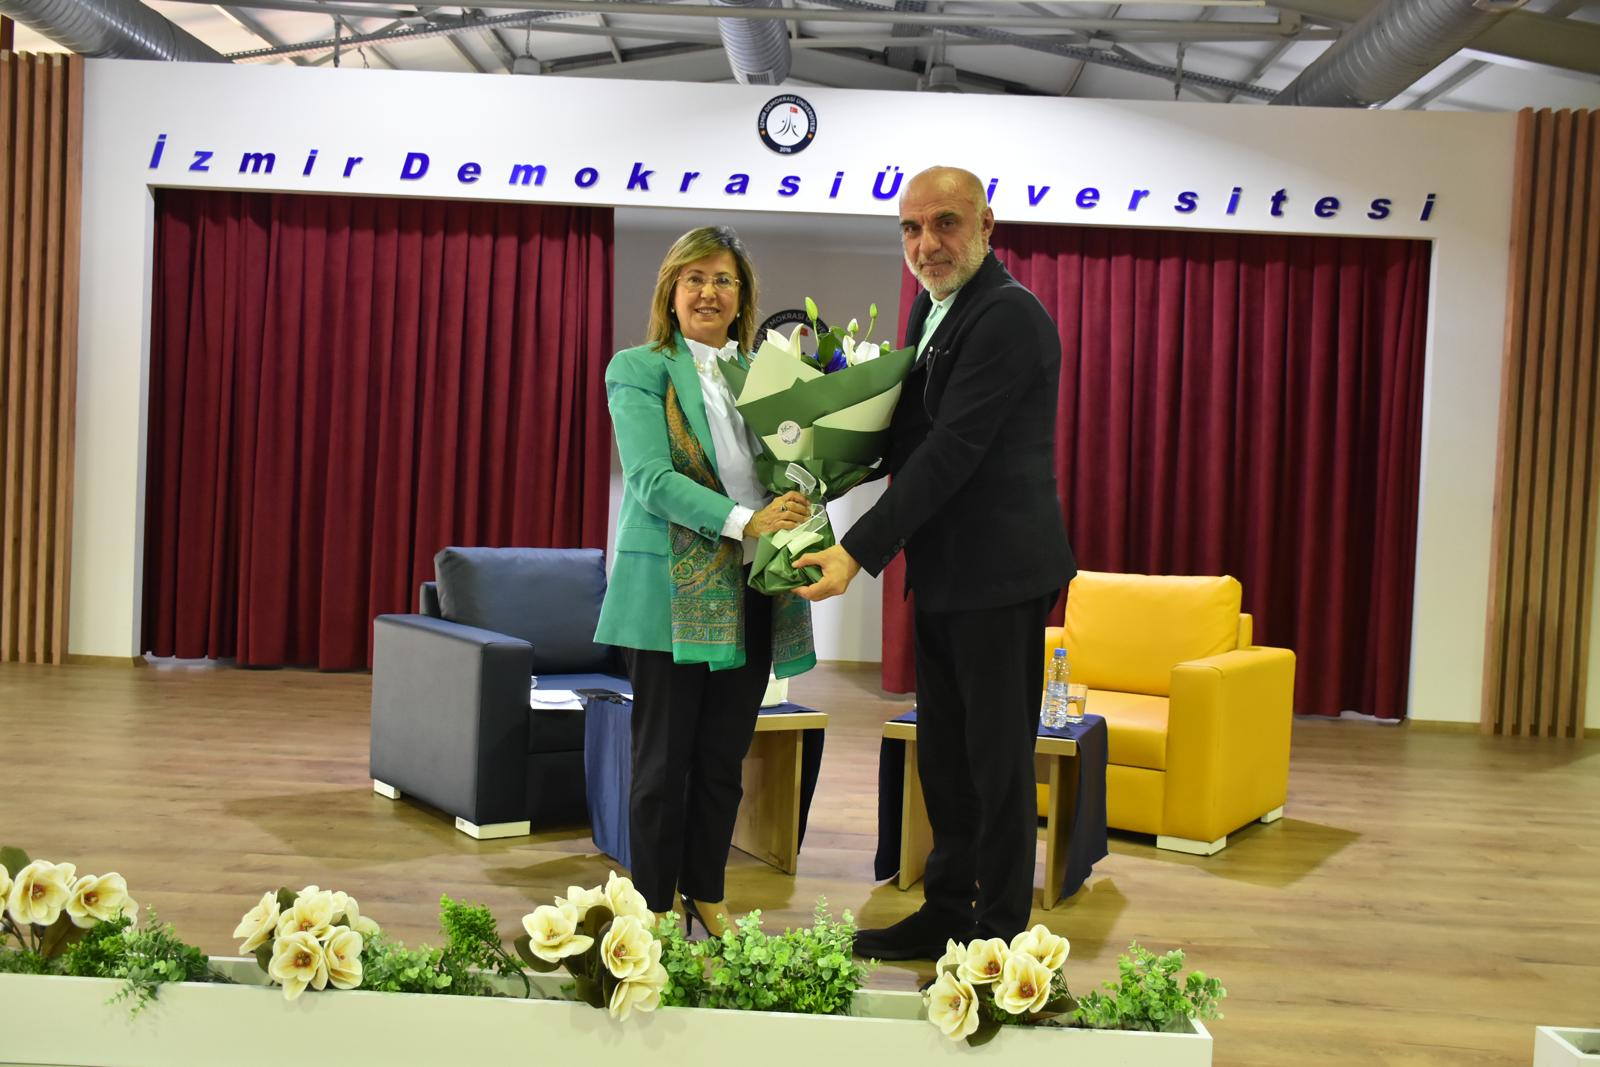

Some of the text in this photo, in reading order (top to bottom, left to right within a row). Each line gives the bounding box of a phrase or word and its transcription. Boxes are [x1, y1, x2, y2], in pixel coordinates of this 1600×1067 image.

[149, 133, 1436, 222] İzmir Demokrasi Üiversitesi
